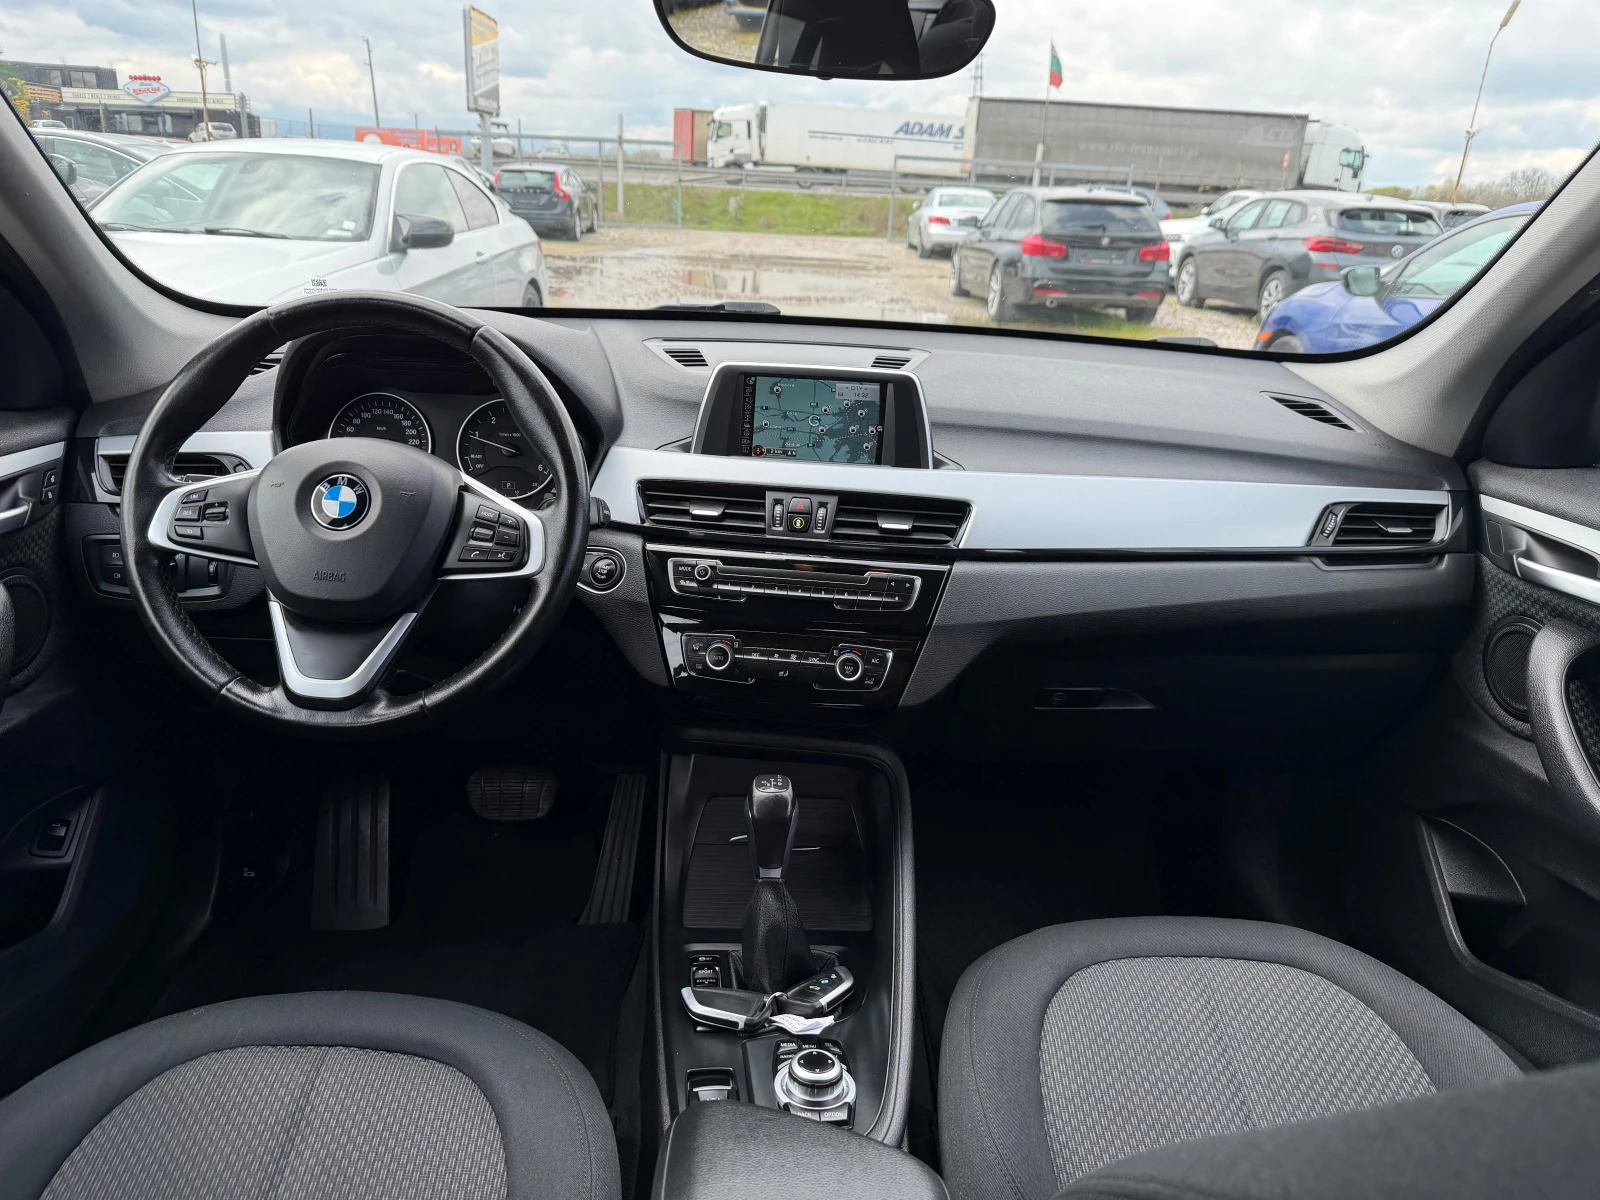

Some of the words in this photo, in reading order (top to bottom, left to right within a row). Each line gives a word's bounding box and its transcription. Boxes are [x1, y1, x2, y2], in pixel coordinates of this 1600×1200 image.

[894, 120, 952, 139] ADAM
[491, 416, 496, 424] 2
[538, 464, 543, 472] 6
[319, 476, 365, 495] BMW
[313, 570, 346, 582] AIRBAG
